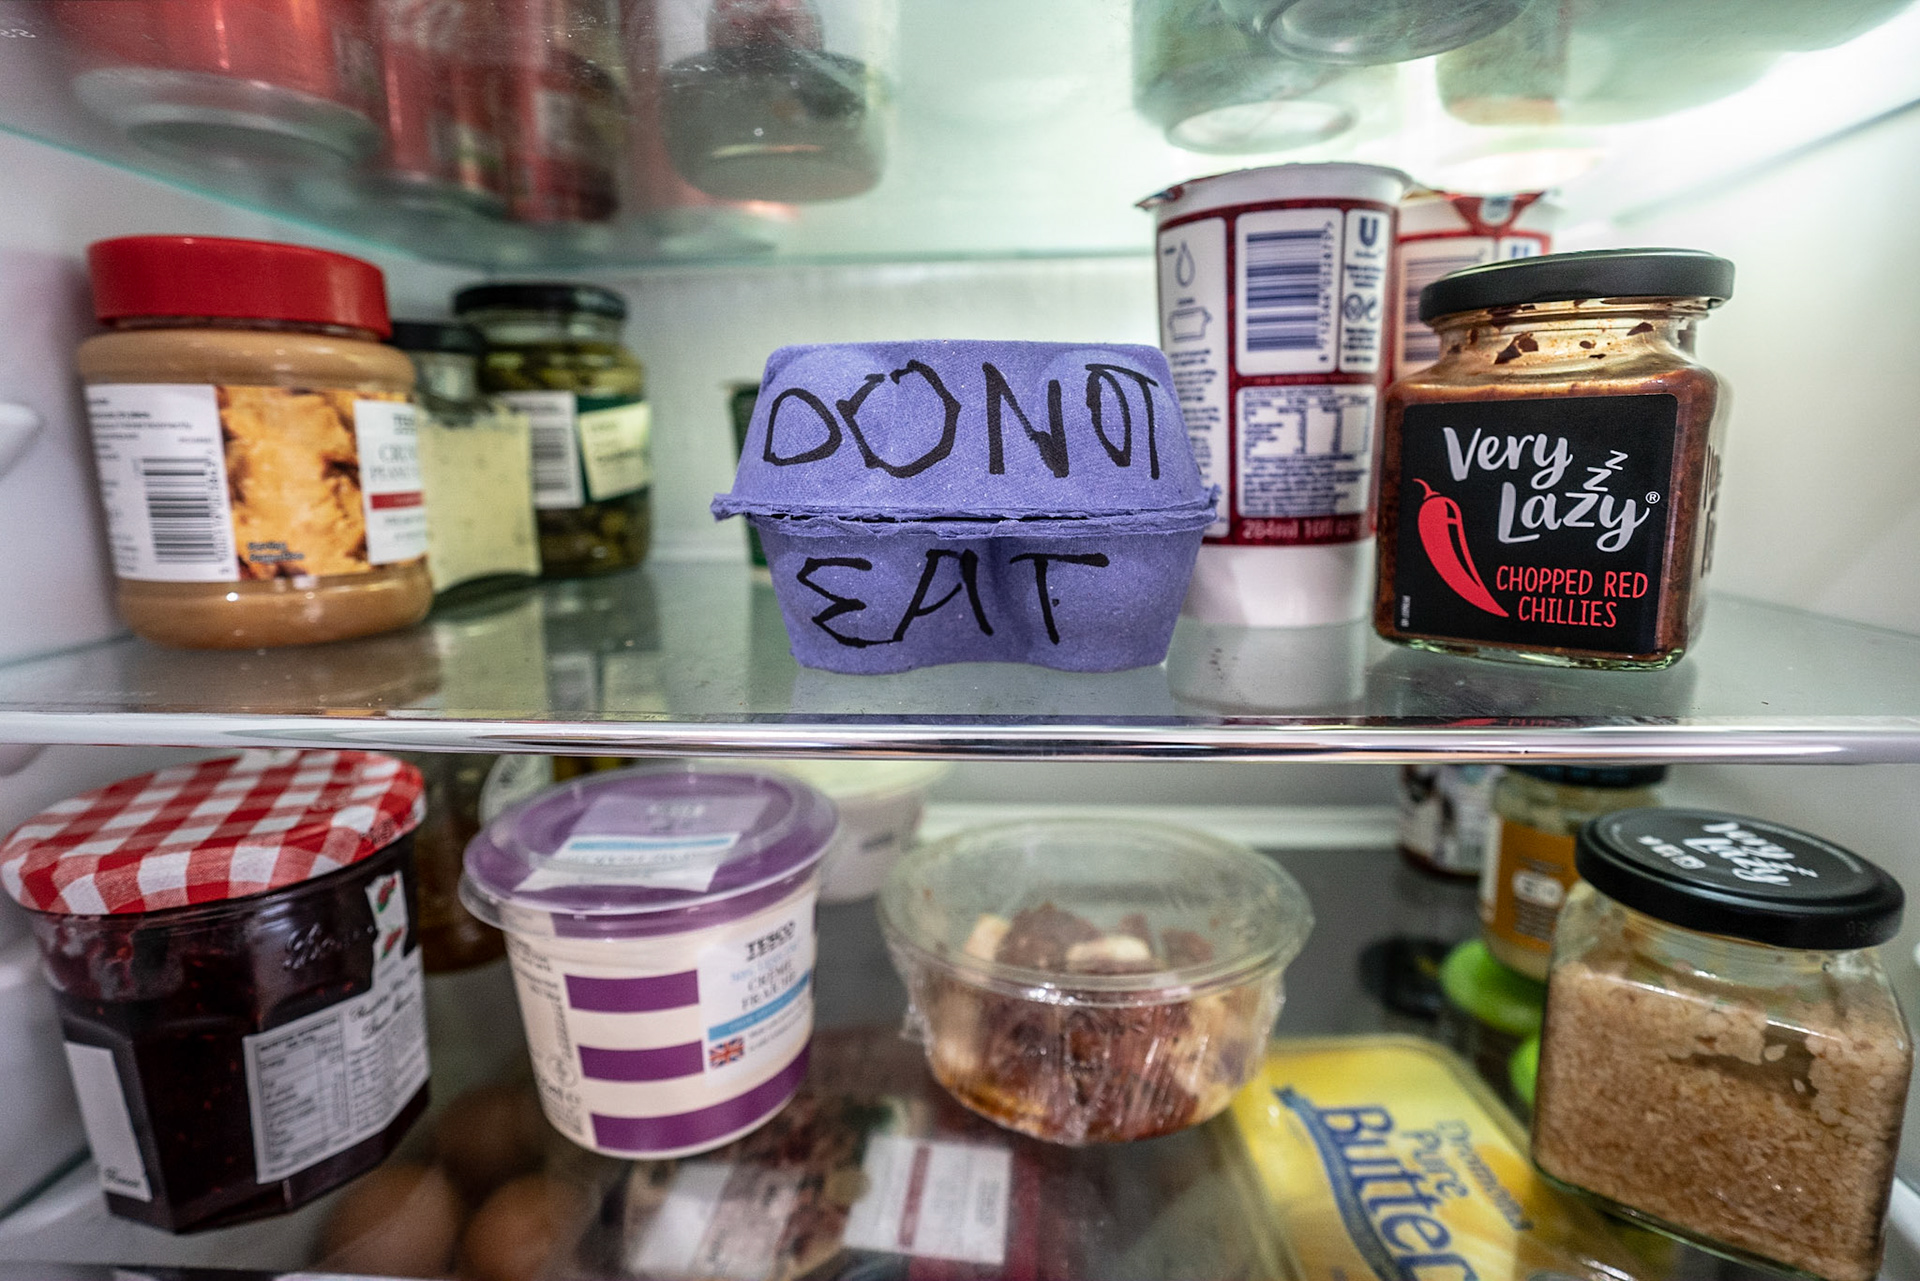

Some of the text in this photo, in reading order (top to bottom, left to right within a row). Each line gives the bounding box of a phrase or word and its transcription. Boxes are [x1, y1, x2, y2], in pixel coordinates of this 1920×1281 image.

[1442, 426, 1574, 490] Very
[797, 549, 1109, 648] EAT
[1496, 565, 1649, 599] CHOPPED RED
[1518, 596, 1617, 628] CHILLIES
[1402, 1128, 1469, 1198] Pure
